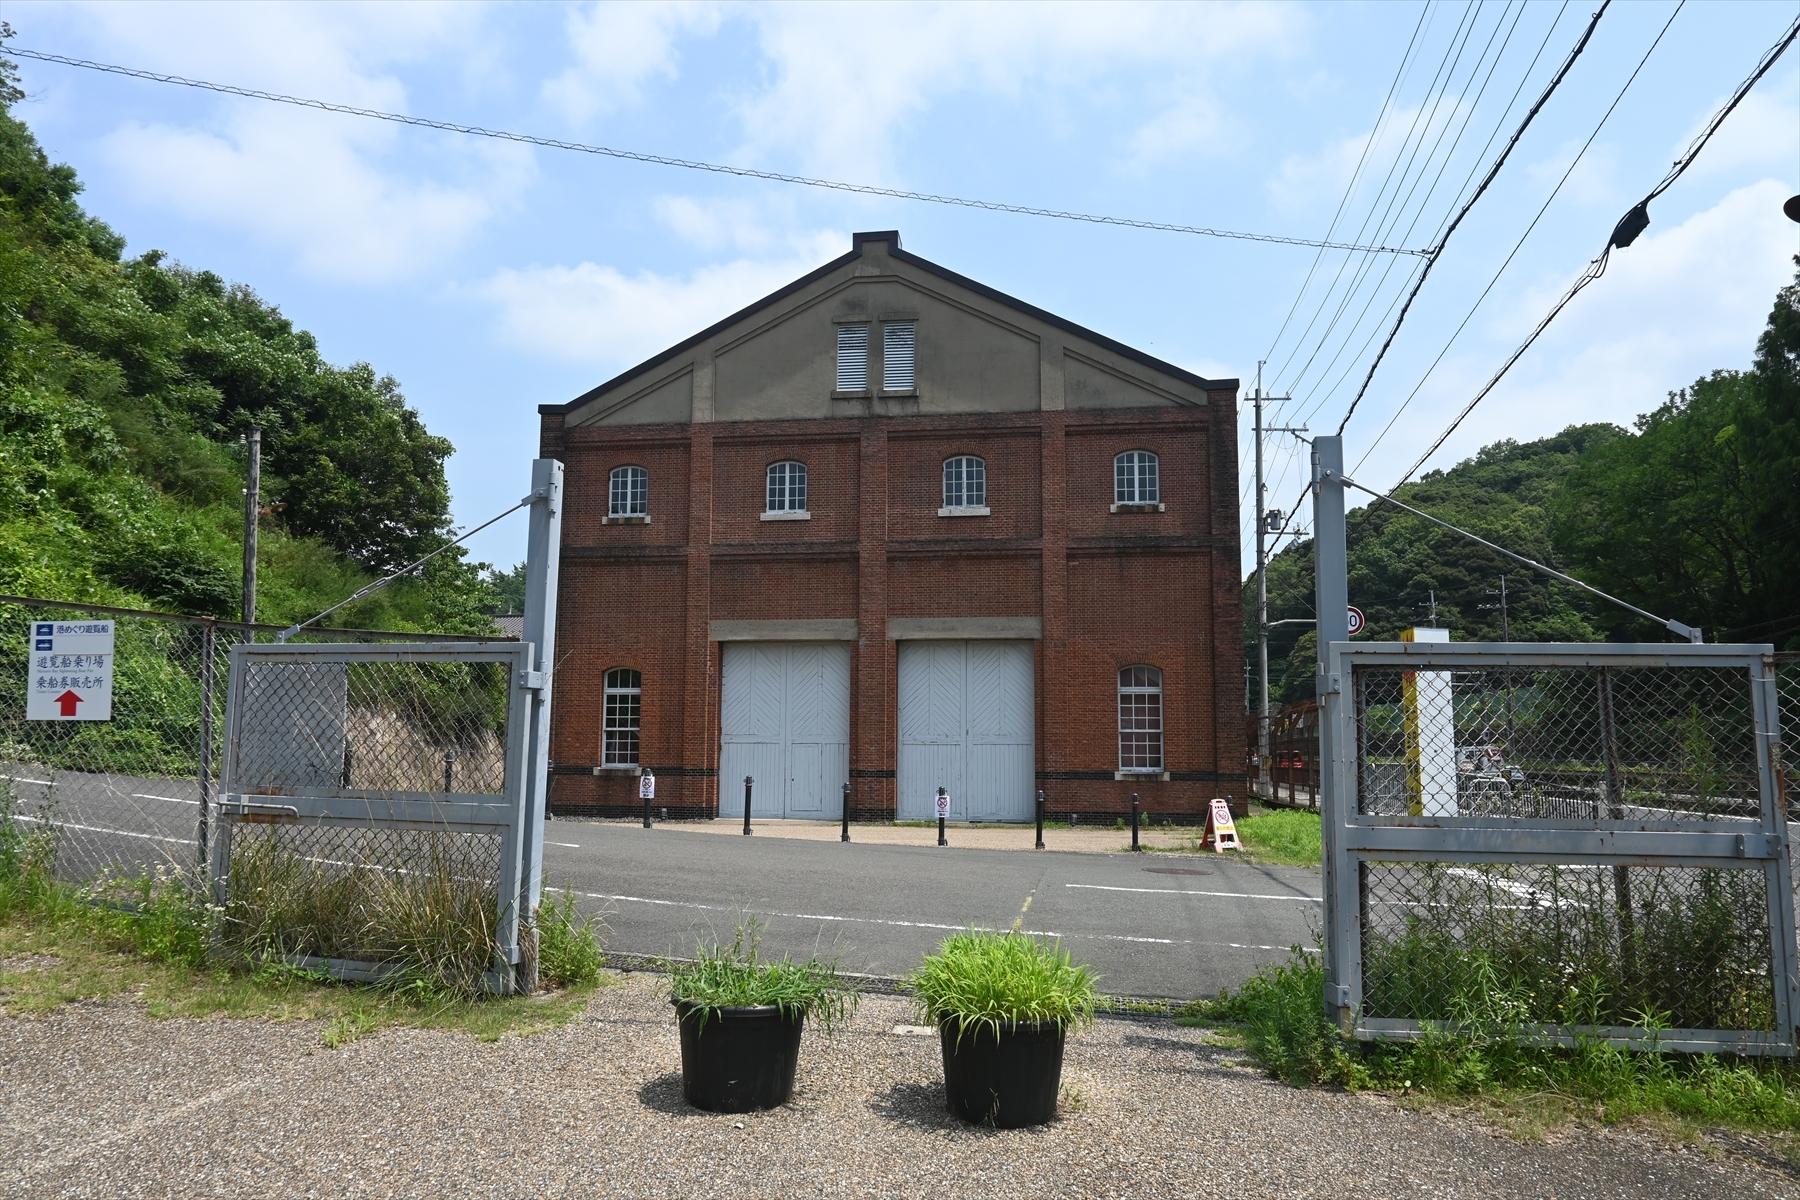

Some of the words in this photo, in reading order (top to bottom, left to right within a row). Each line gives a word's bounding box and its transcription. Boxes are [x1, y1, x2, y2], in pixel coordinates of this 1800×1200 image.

[56, 624, 109, 633] 港めぐり遊覧船
[37, 655, 104, 668] 遊覧船乗り場
[36, 675, 104, 689] 乗船券販売所
